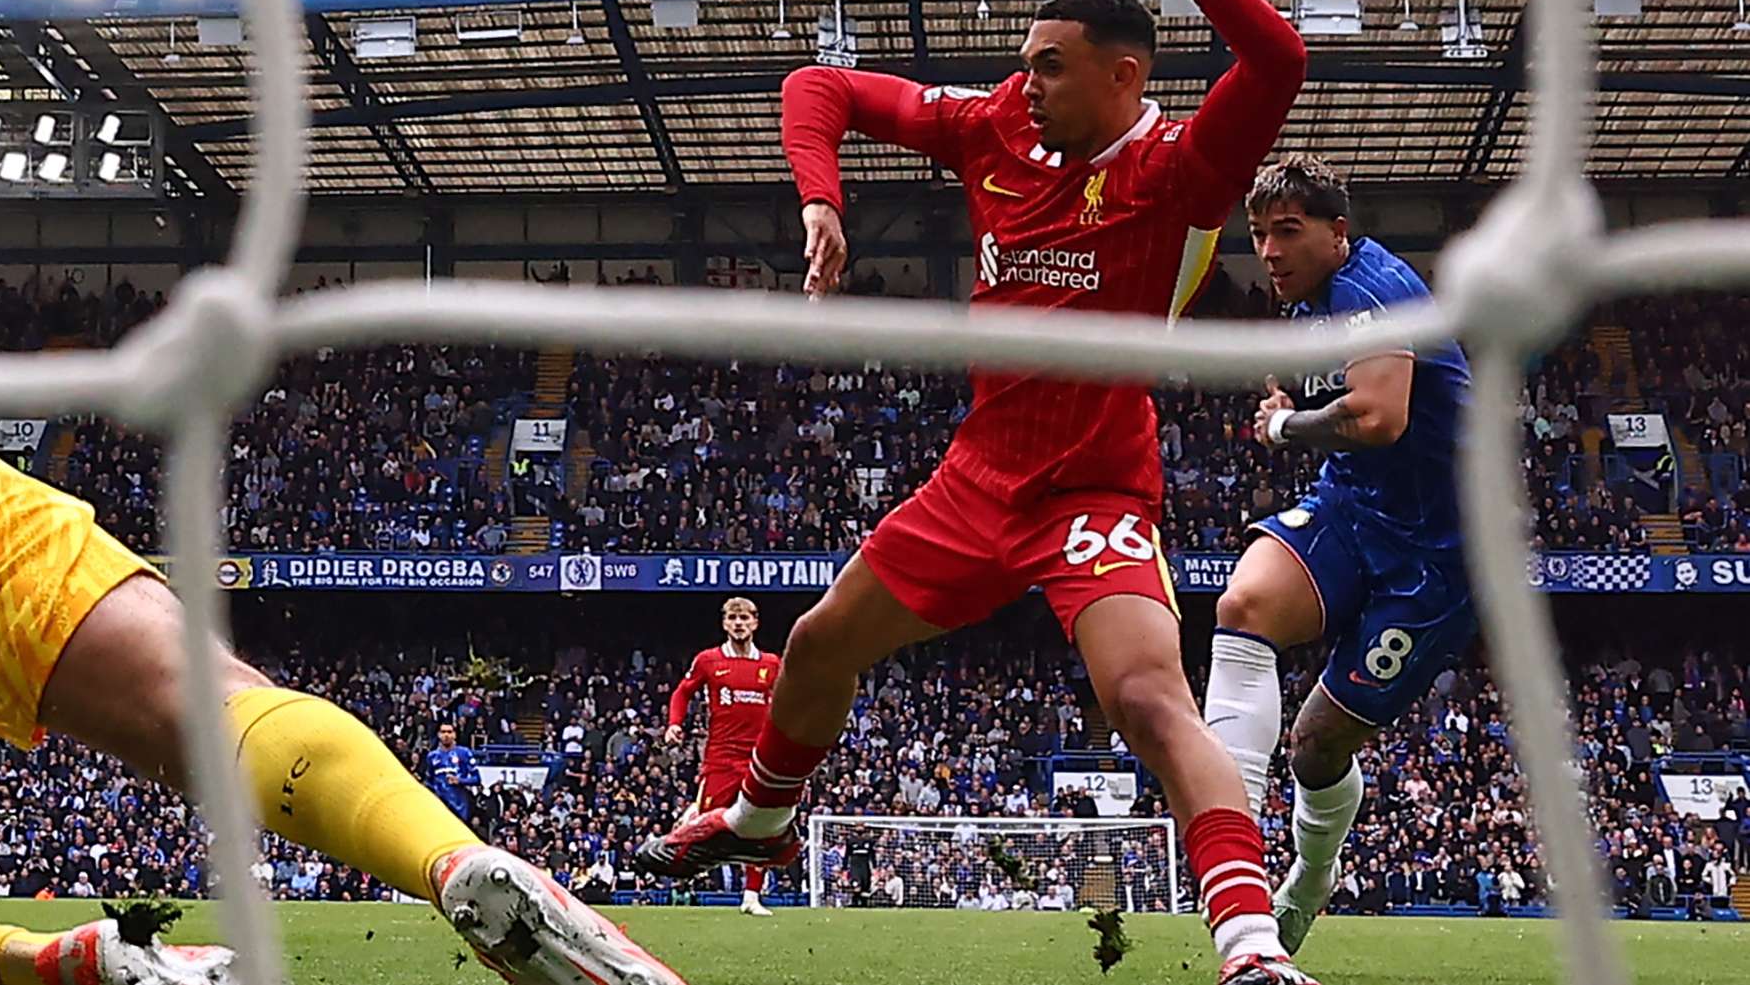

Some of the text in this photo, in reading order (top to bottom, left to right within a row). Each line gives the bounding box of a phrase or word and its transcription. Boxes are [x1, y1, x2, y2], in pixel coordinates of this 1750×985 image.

[1001, 248, 1096, 270] standard
[13, 422, 34, 437] 10
[533, 421, 551, 437] 11
[1625, 416, 1647, 433] 13
[1062, 513, 1154, 566] 66
[289, 559, 485, 577] DIDIER DROGBA
[529, 564, 637, 579] 547 SW6
[695, 558, 835, 586] JT CAPTAIN
[292, 577, 485, 587] THE BIG MAN FOR THE BIG OCCASION
[1365, 628, 1413, 680] 8
[500, 770, 518, 785] 11
[1084, 775, 1106, 791] 12
[1690, 778, 1714, 795] 13
